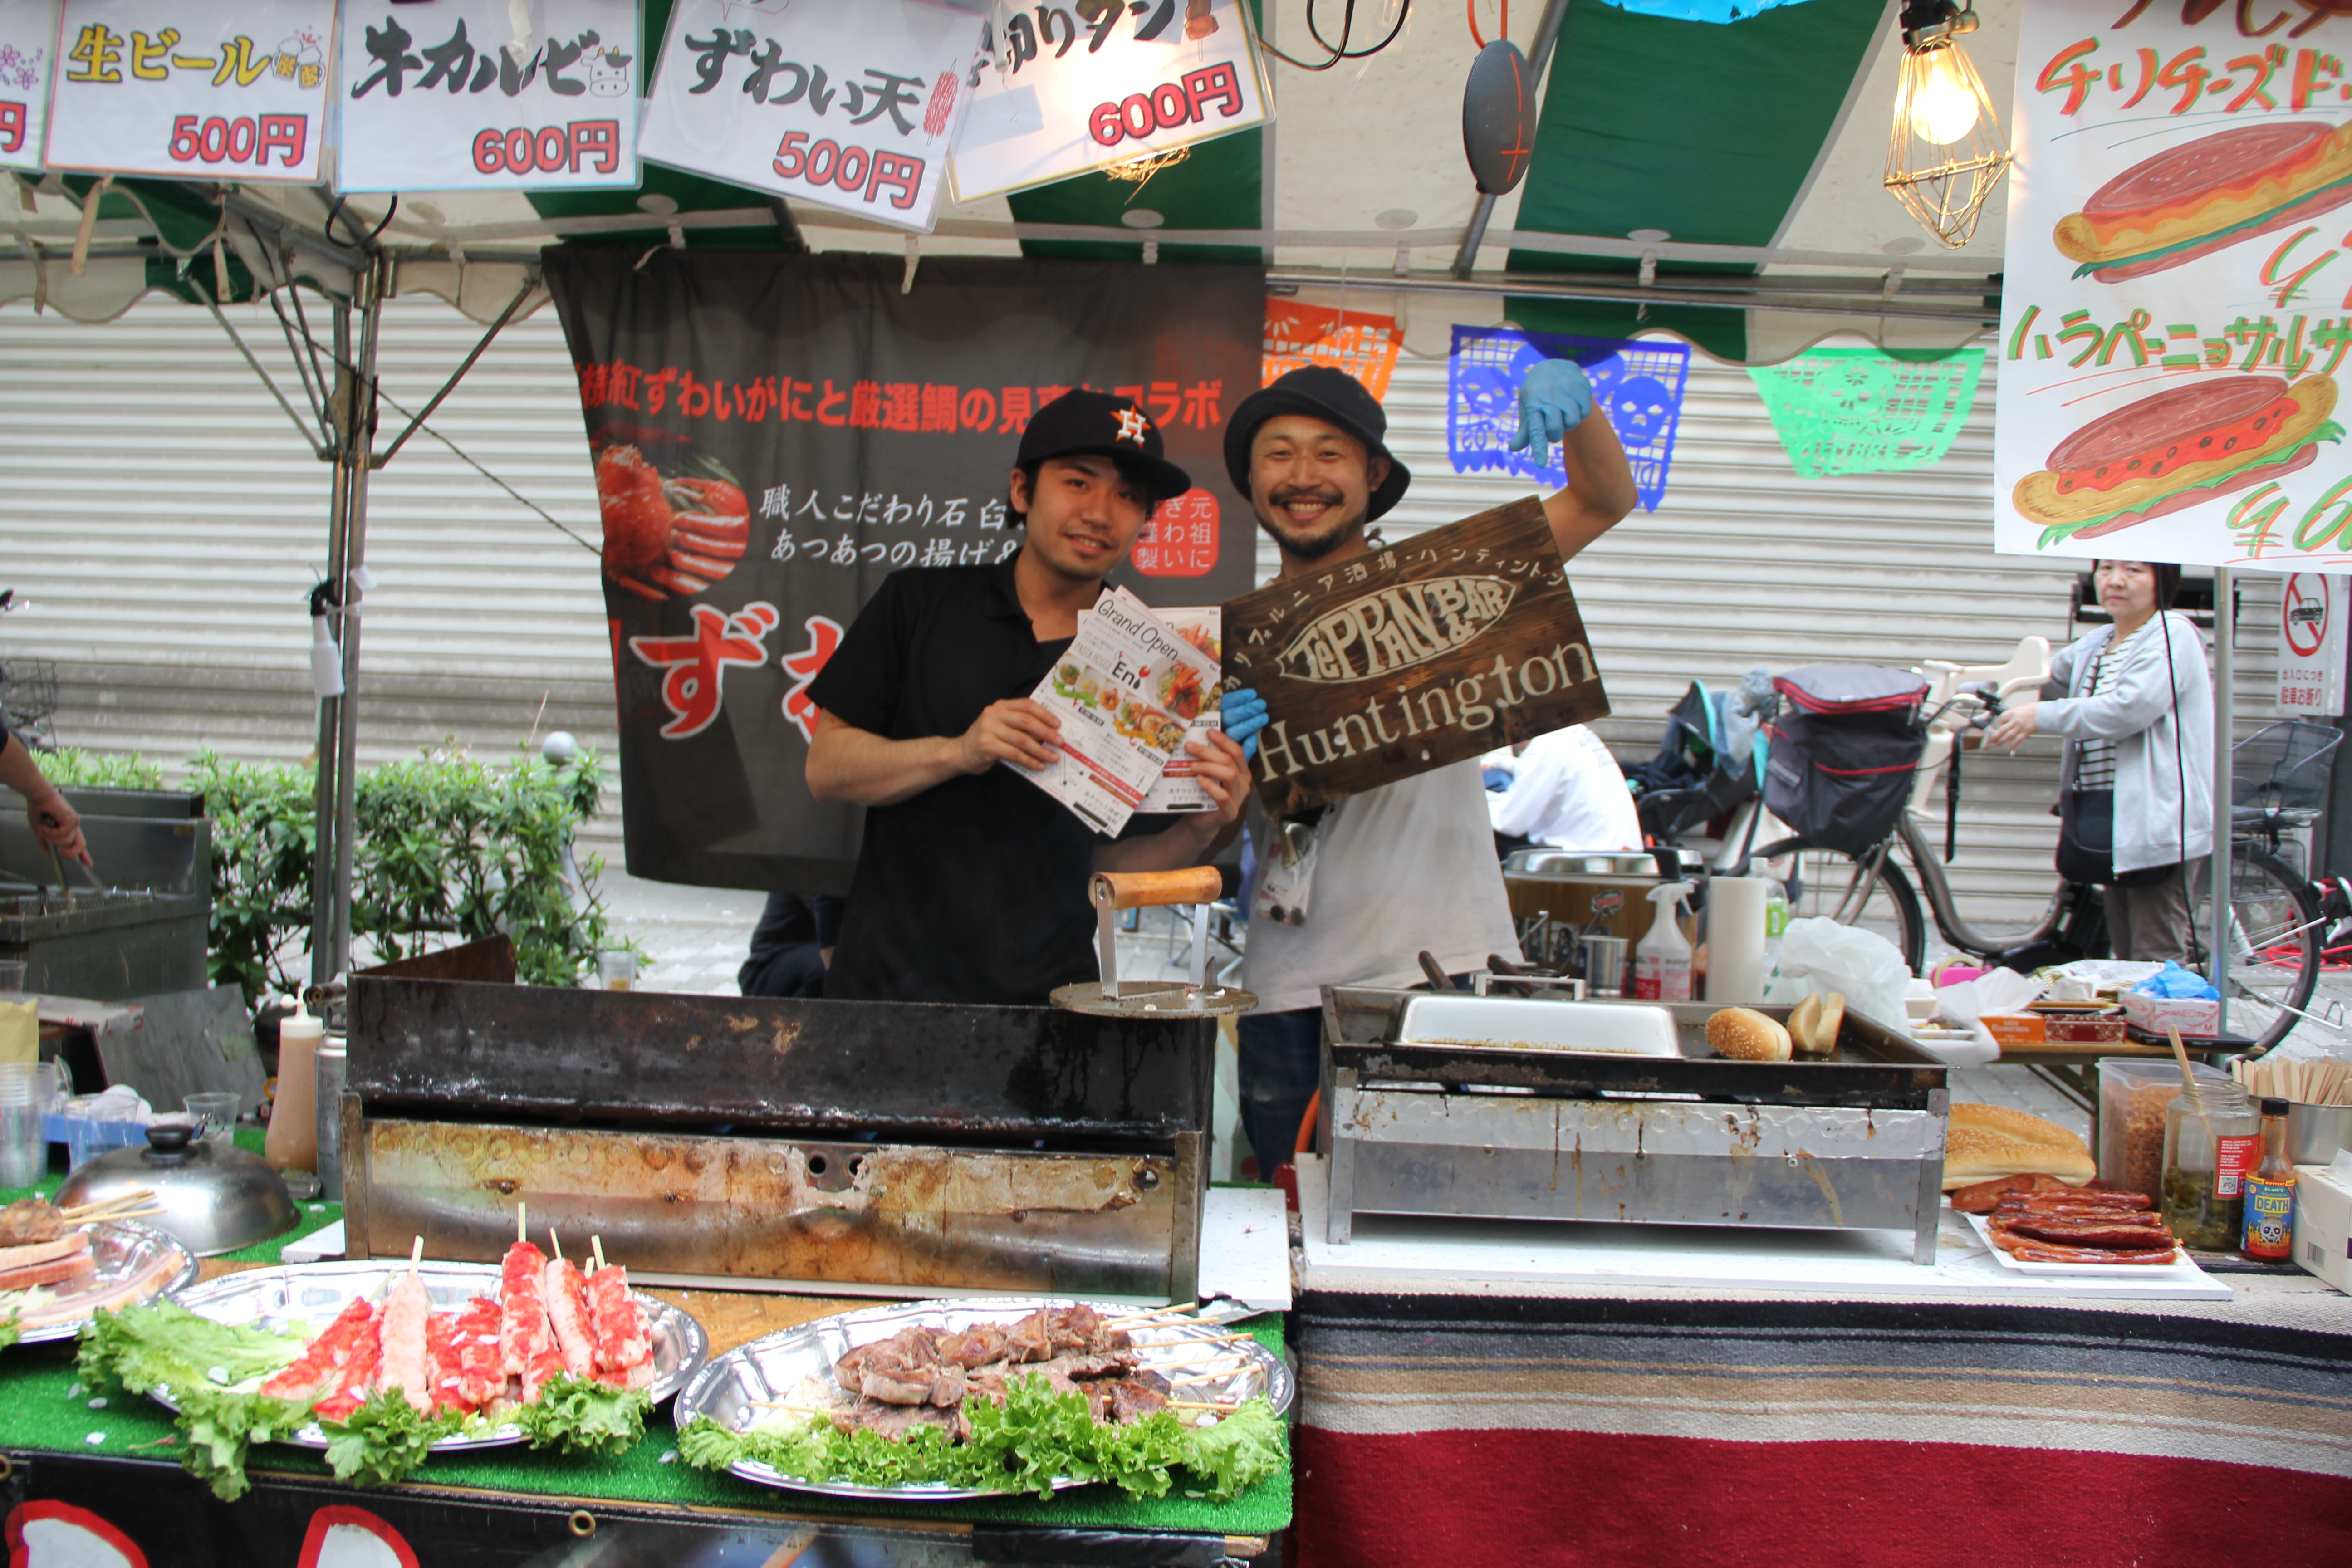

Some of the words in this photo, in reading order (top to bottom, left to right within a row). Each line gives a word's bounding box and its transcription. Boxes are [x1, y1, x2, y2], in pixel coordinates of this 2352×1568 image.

[67, 24, 272, 87] 生ビール
[351, 15, 600, 99] 牛カルビ
[685, 28, 926, 136] ずわい天
[2036, 36, 2352, 115] チリチーズド
[1089, 61, 1244, 146] 600円
[168, 113, 308, 167] 500円
[472, 120, 620, 175] 600円
[773, 131, 926, 210] 500円
[2008, 304, 2352, 380] ハラペーニョサルサ
[1118, 408, 1146, 443] H
[1163, 495, 1187, 568] ぎわい
[1188, 497, 1212, 568] 元祖に
[2226, 472, 2352, 560] ¥6
[1098, 599, 1146, 637] Grand
[1141, 626, 1179, 662] Open
[1426, 578, 1504, 621] BAR
[1074, 641, 1094, 660] PASTA
[1091, 652, 1114, 671] HOUSE
[2282, 669, 2323, 681] 出入口につき
[1256, 641, 1598, 782] Huntington
[2281, 686, 2322, 706] 駐車お断り
[2257, 1198, 2289, 1211] DEATH
